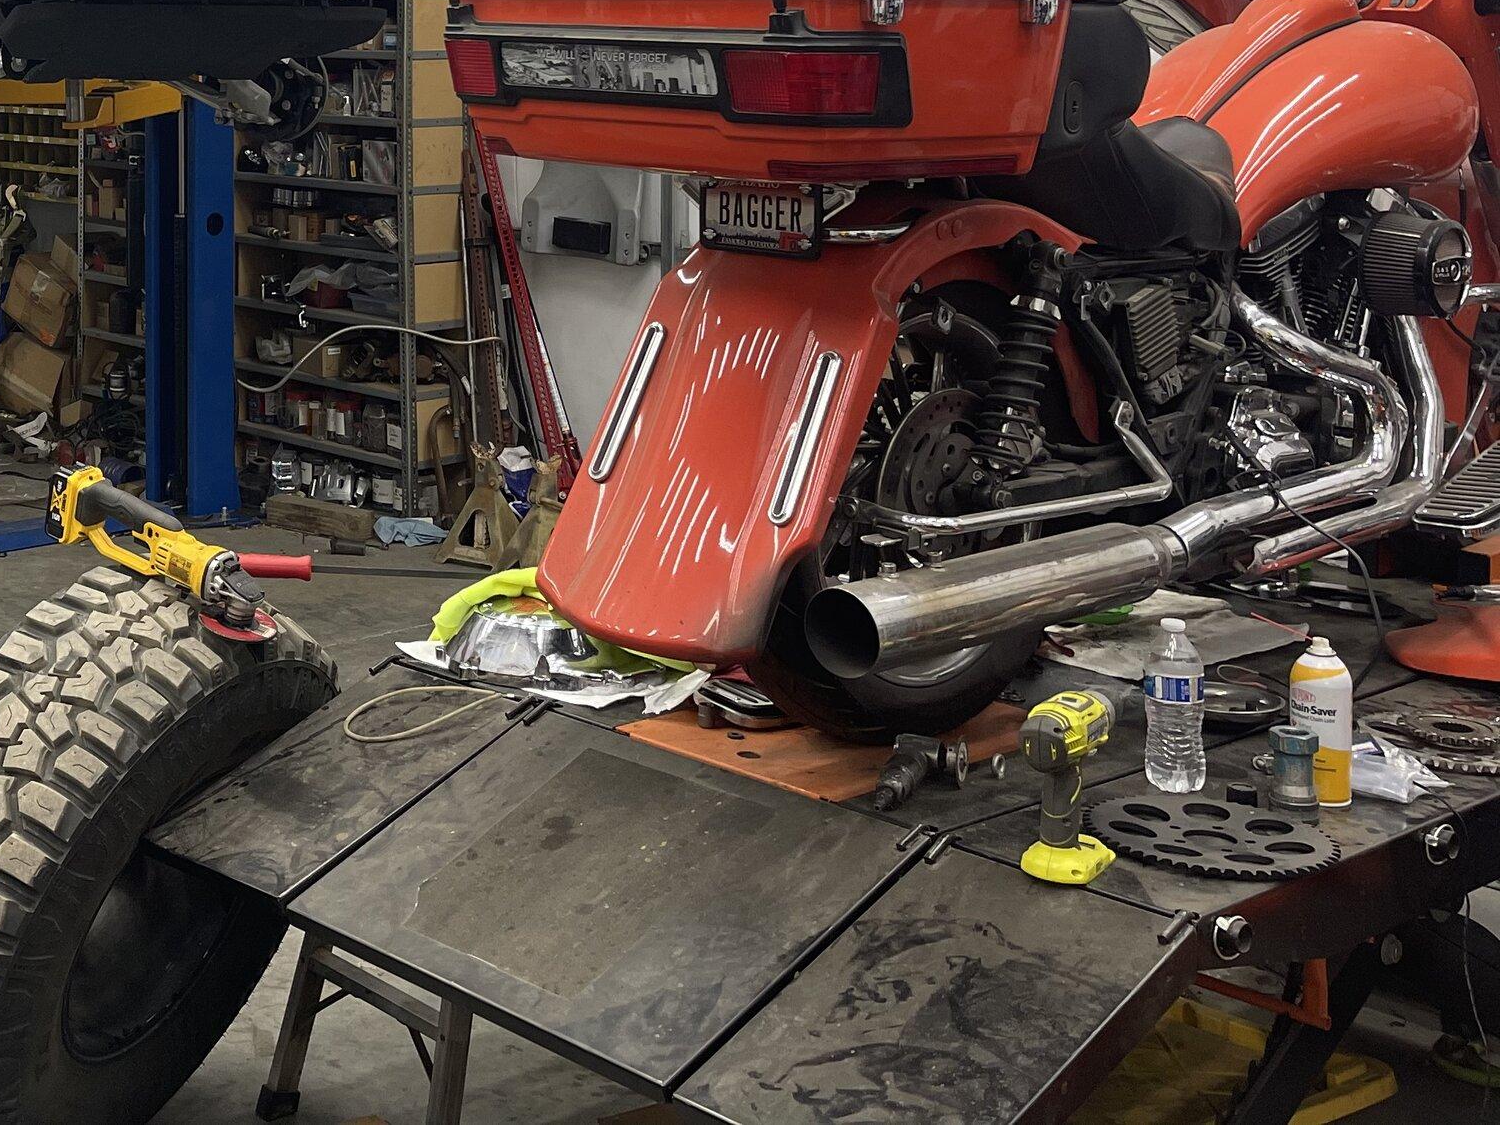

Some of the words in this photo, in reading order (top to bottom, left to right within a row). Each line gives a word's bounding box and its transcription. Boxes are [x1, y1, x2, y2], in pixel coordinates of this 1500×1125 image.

[553, 50, 576, 60] WILL
[593, 52, 626, 62] NEVER
[628, 53, 668, 63] FORGET
[719, 191, 802, 233] BAGGER
